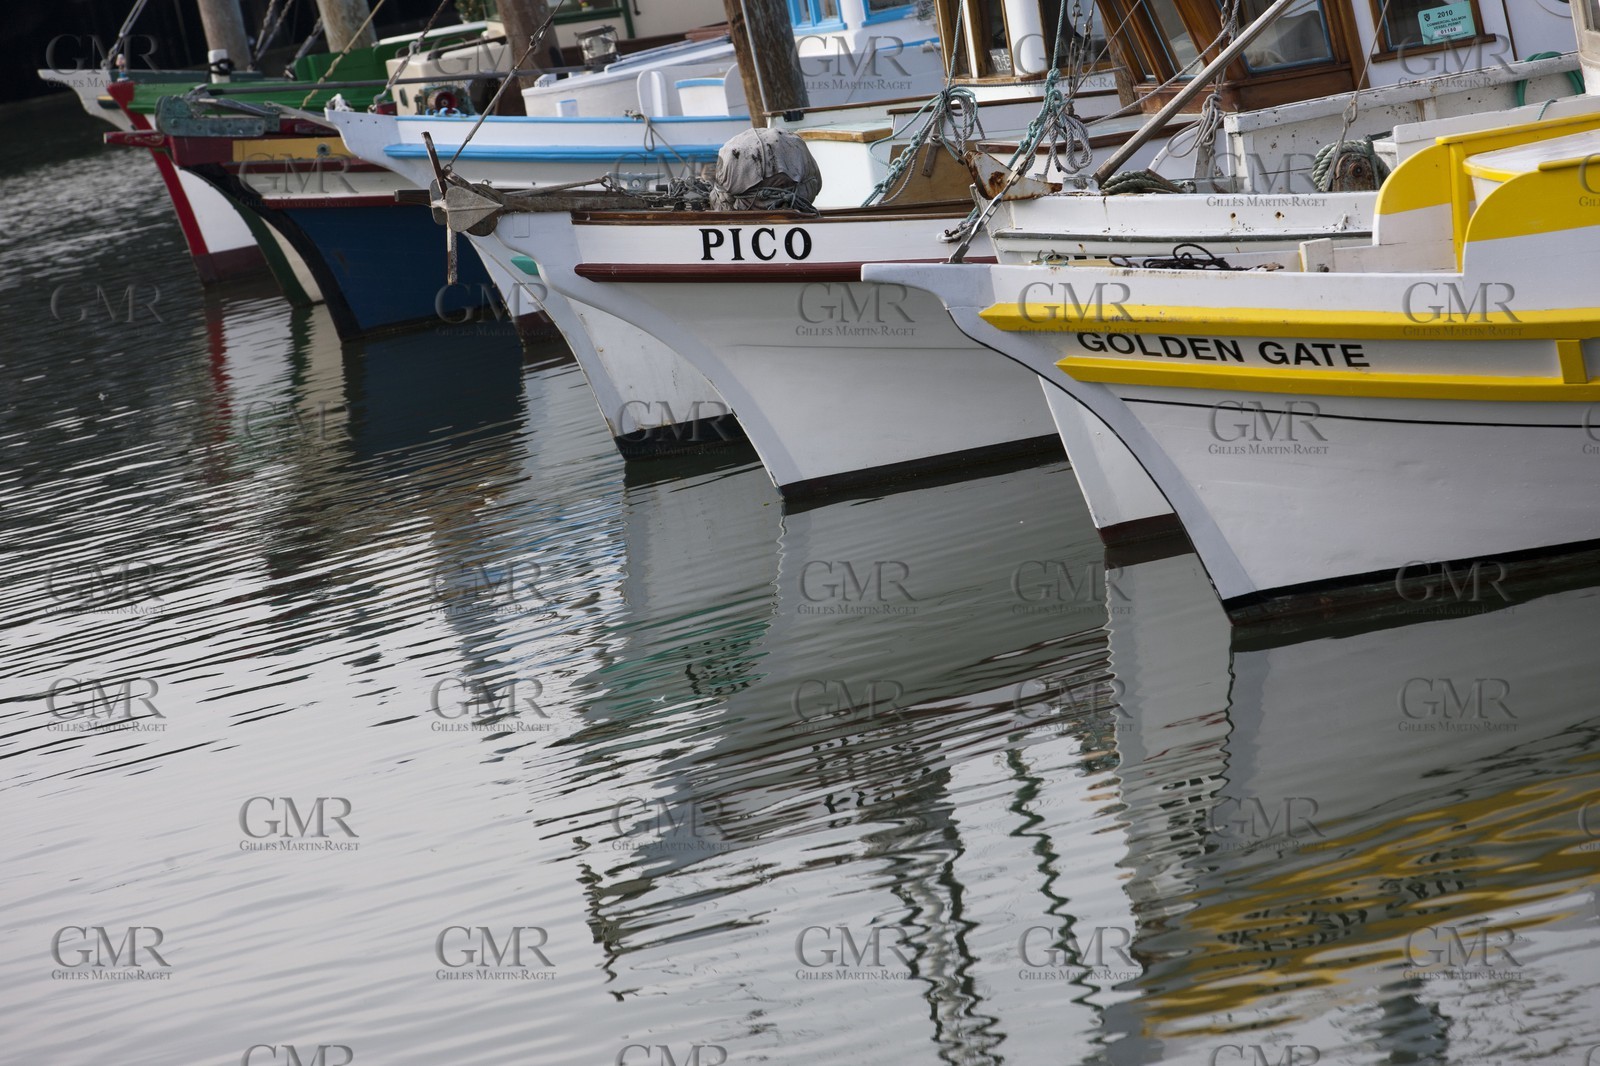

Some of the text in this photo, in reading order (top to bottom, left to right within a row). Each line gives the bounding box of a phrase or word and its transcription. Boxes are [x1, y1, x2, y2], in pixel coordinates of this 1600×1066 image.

[1427, 19, 1450, 27] COMMERCIAL
[1437, 10, 1453, 18] 2010
[698, 227, 812, 261] PICO
[1076, 332, 1371, 368] GOLDEN GATE
